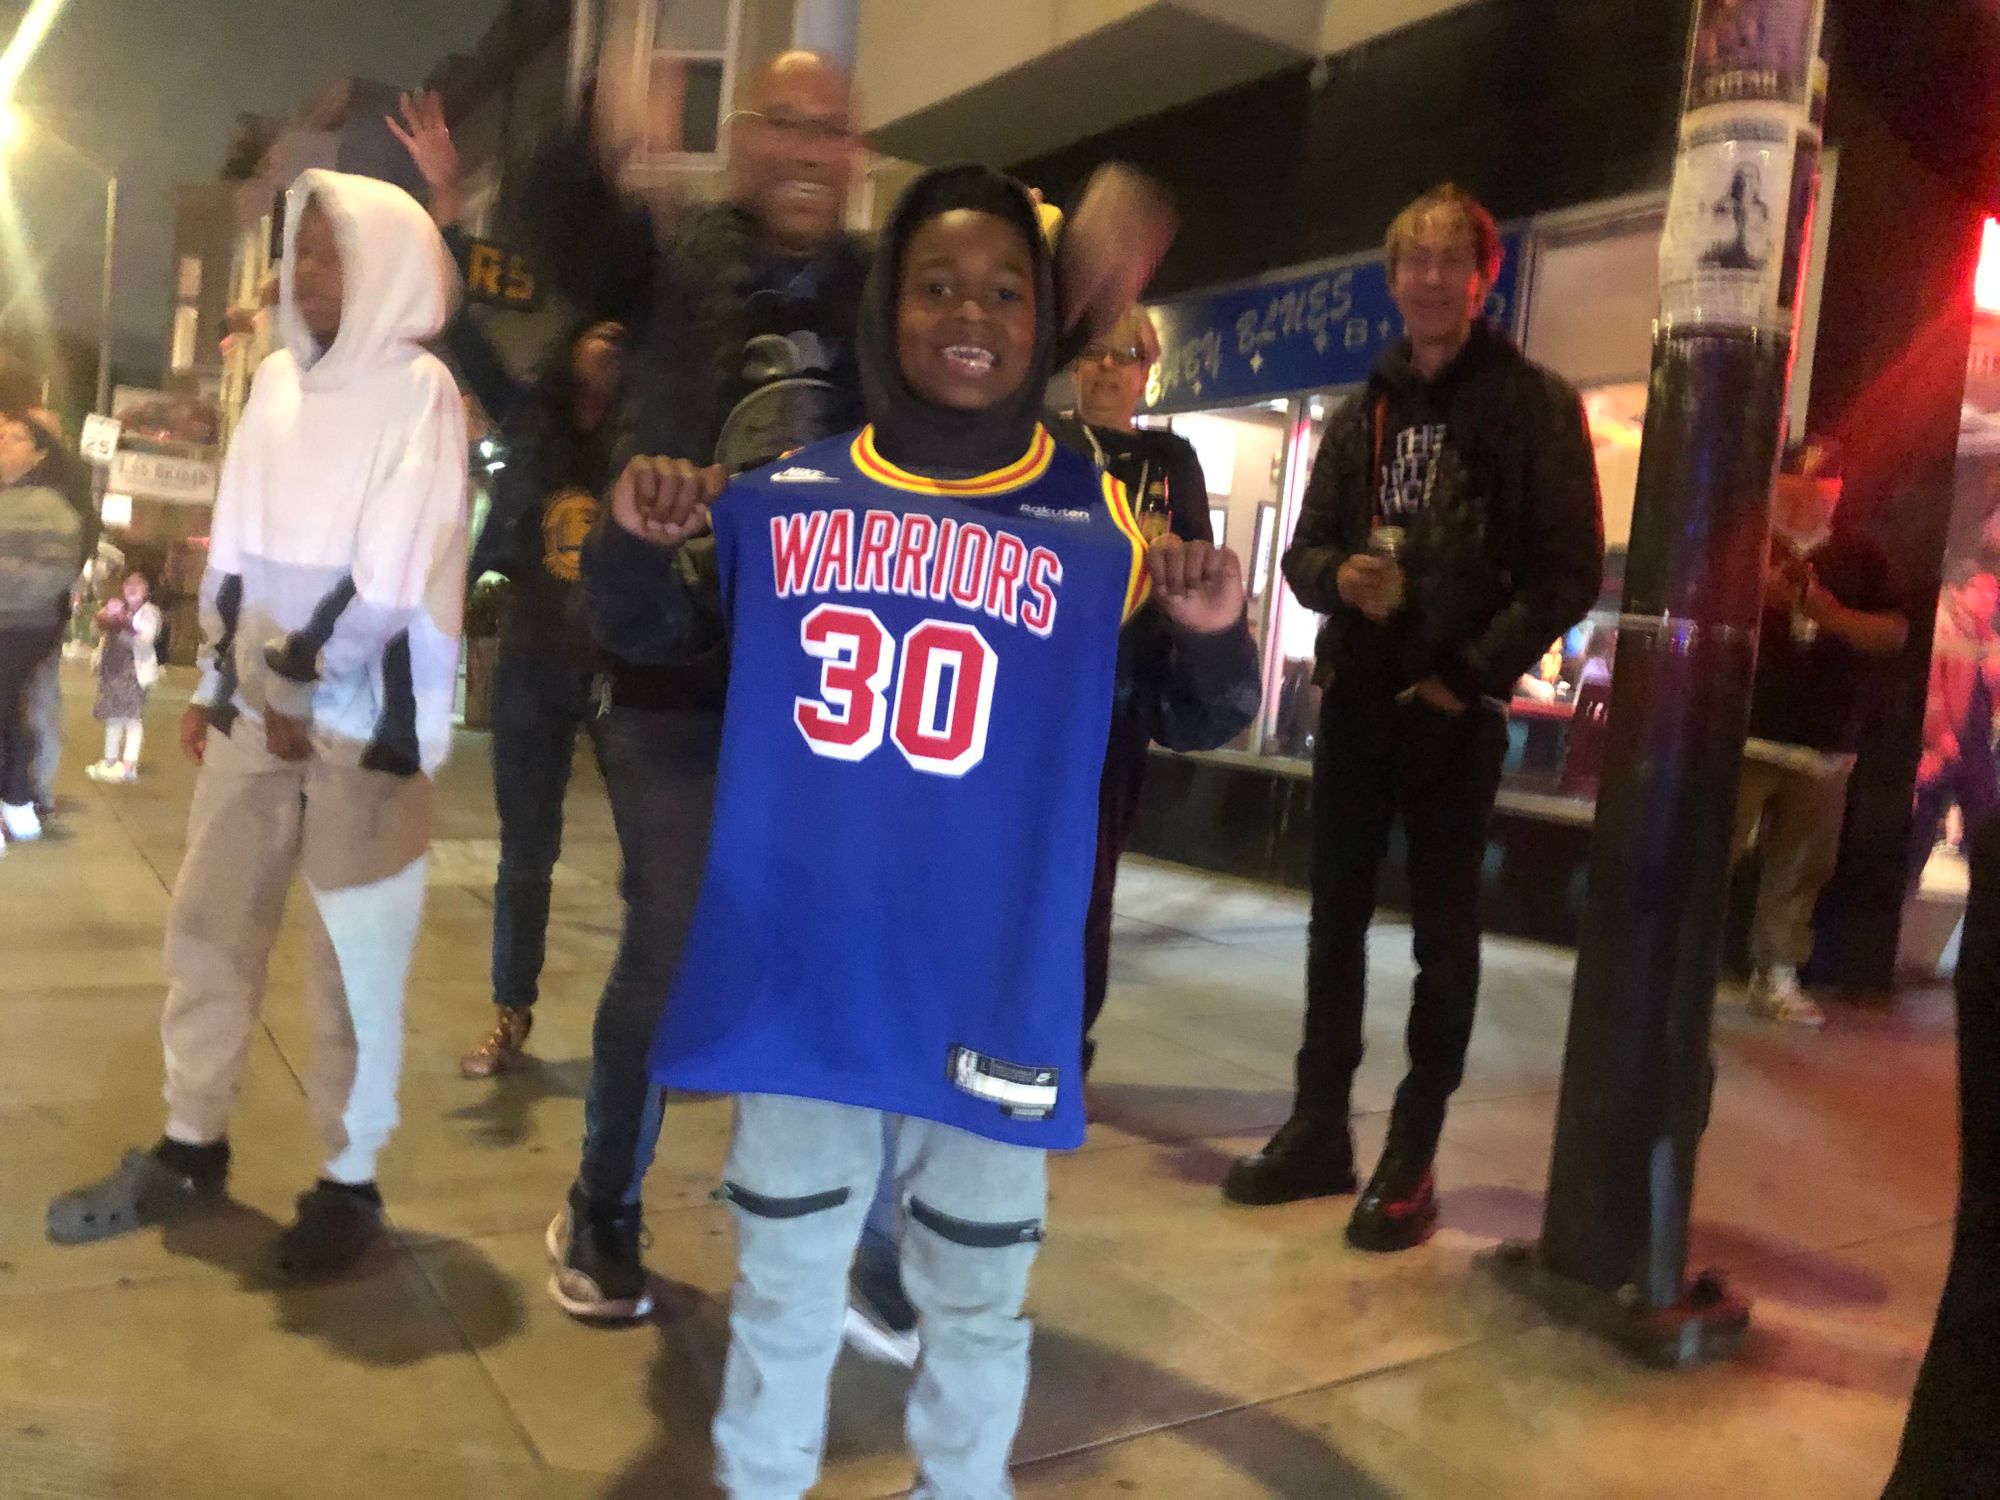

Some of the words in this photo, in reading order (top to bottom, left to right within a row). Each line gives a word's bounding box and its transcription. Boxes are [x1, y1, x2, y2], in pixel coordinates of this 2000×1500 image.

[770, 508, 1064, 639] WARRIORS
[1019, 503, 1091, 520] Rakuten
[794, 602, 999, 779] 30
